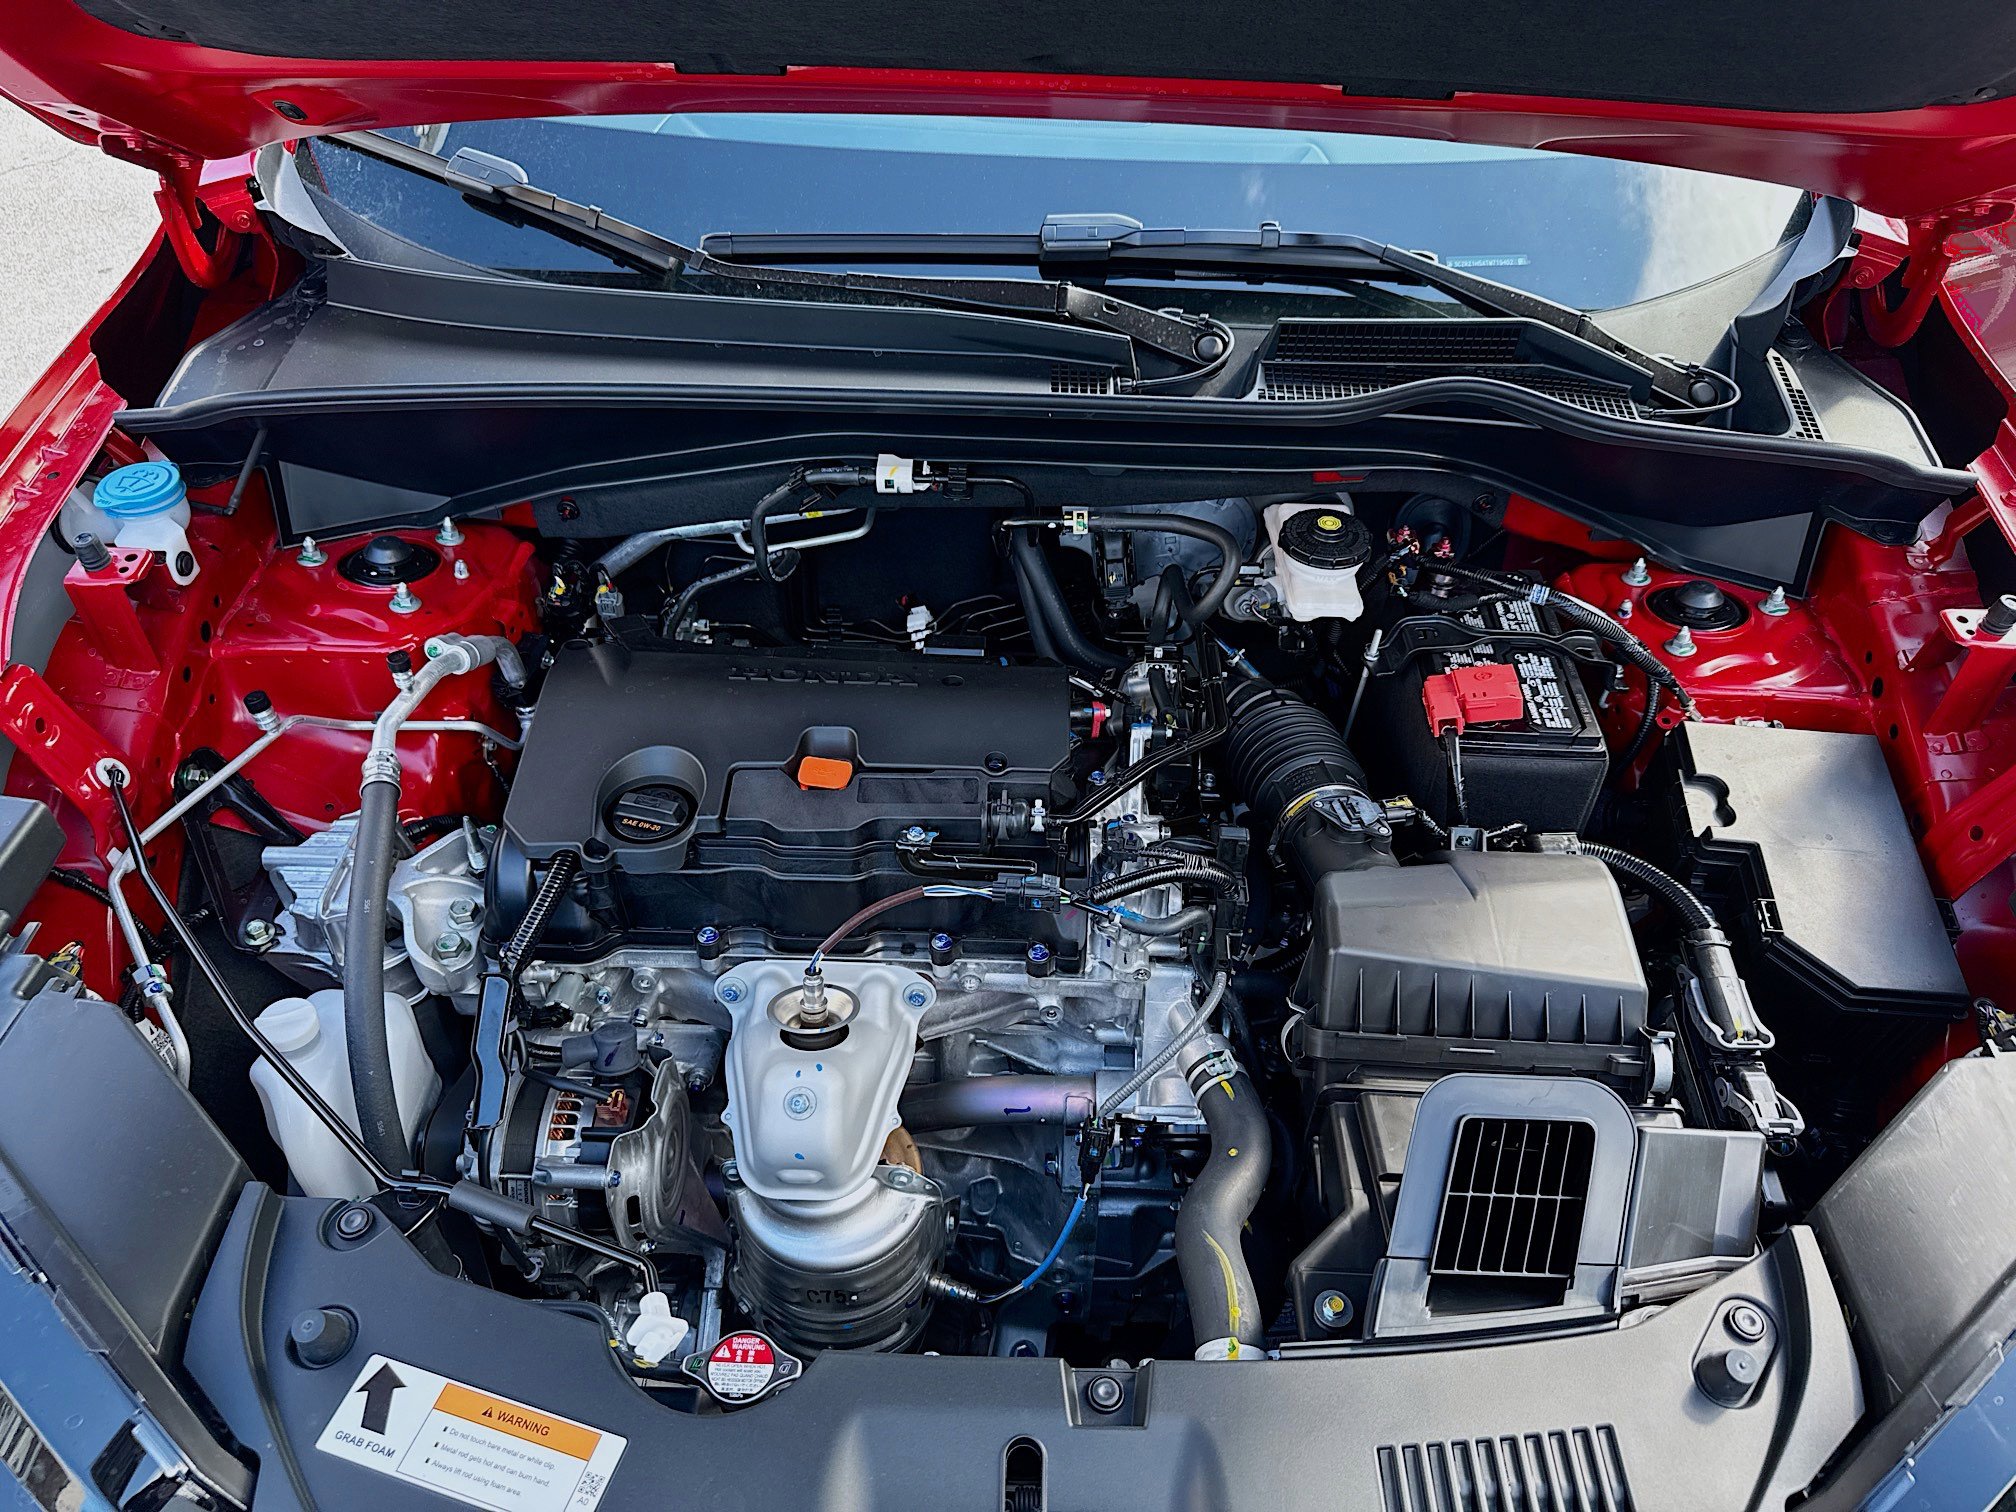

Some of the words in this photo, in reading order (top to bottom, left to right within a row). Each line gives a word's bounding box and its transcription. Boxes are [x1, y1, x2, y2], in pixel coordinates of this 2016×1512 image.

[729, 667, 919, 687] HONDA
[621, 818, 638, 827] SAE
[638, 821, 661, 831] 0W-20
[497, 1410, 551, 1436] WARNING
[335, 1430, 365, 1447] GRAB
[364, 1440, 396, 1459] FOAM
[449, 1427, 459, 1436] Do
[459, 1432, 470, 1440] not
[470, 1436, 487, 1446] touch
[487, 1441, 501, 1451] bare
[501, 1447, 520, 1457] metal
[527, 1456, 543, 1466] white
[431, 1460, 453, 1473] Always
[453, 1467, 462, 1476] lift
[461, 1471, 473, 1479] rod
[473, 1475, 490, 1487] using
[490, 1480, 506, 1490] foam
[440, 1443, 458, 1454] Metal
[458, 1450, 470, 1459] rod
[469, 1454, 482, 1464] gets
[482, 1459, 494, 1468] hot
[493, 1464, 507, 1472] and
[506, 1468, 518, 1476] can
[518, 1470, 533, 1481] burn
